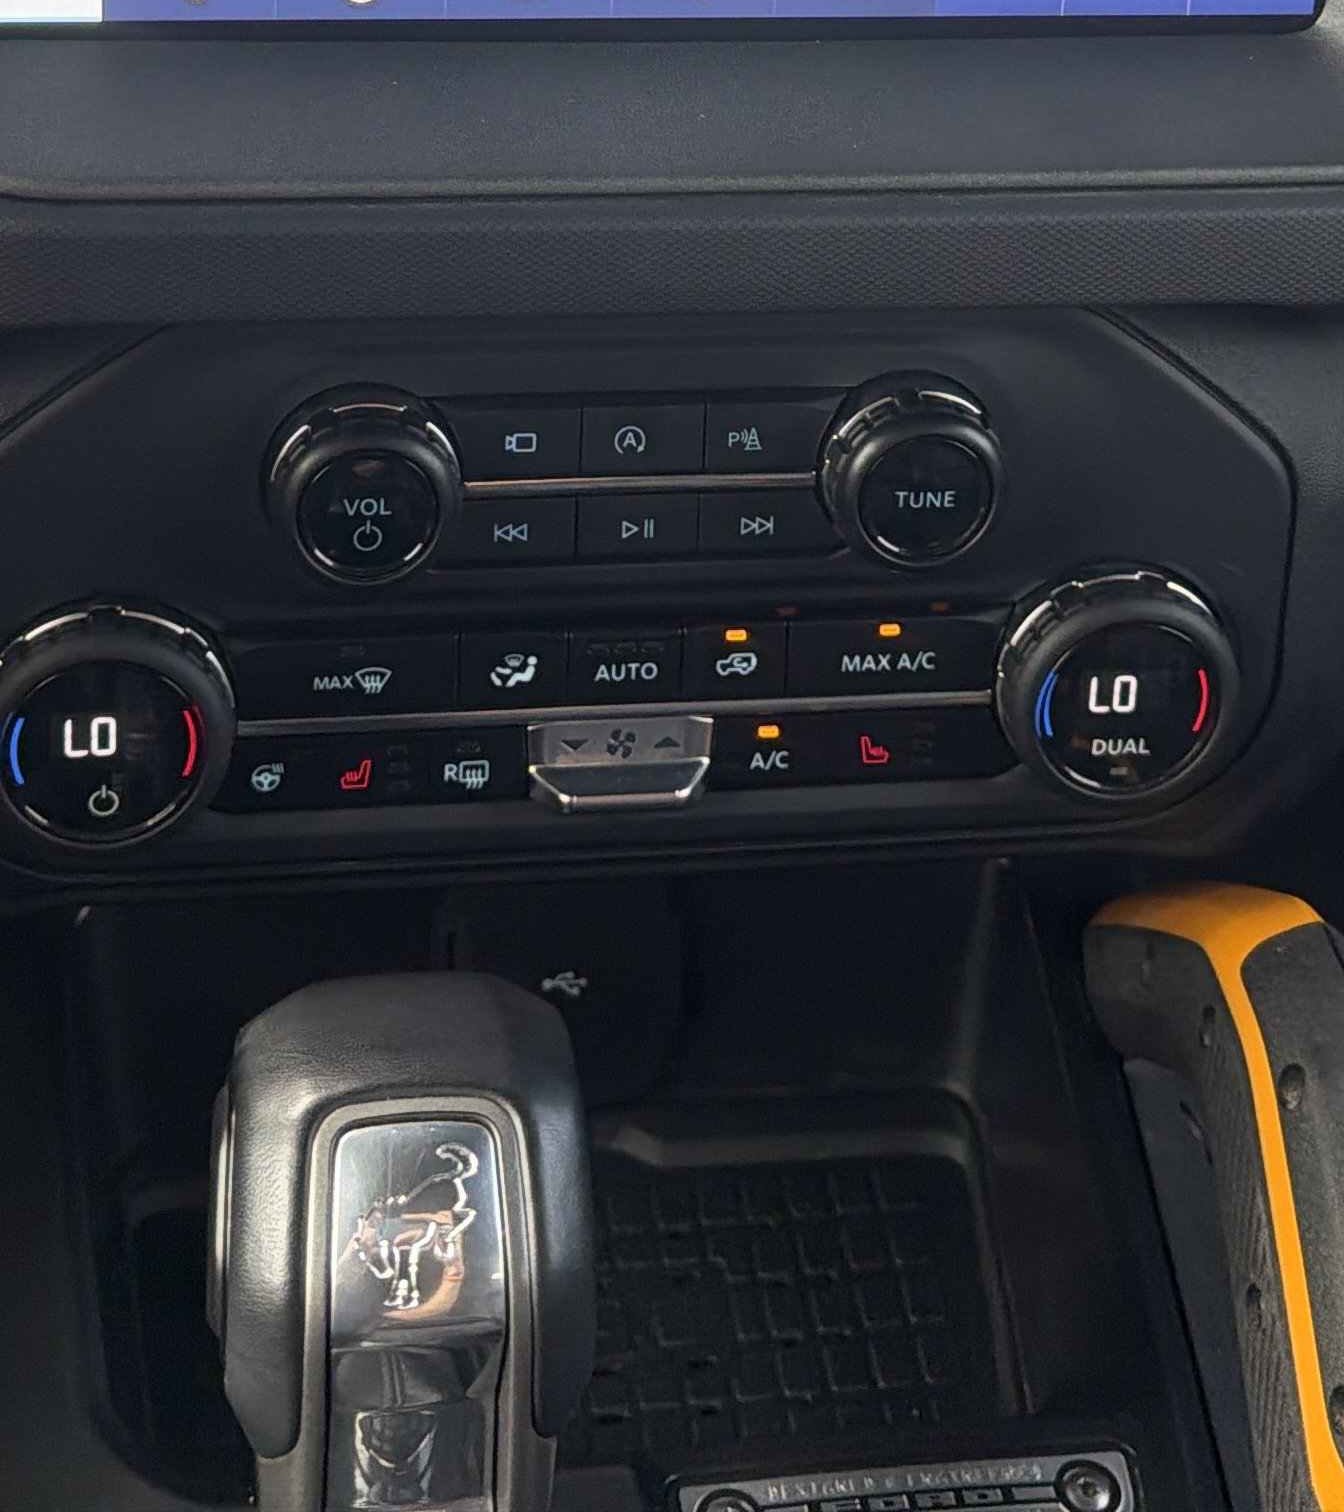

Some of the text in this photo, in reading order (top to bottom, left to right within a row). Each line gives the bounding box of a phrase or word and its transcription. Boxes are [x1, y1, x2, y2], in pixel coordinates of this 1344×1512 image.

[344, 497, 392, 517] VOL
[895, 490, 957, 509] TUNE
[595, 661, 657, 681] AUTO
[841, 651, 936, 672] MAX A/C
[313, 673, 354, 691] MAX
[1088, 675, 1138, 713] LO
[64, 716, 117, 758] LO
[1091, 738, 1149, 756] DUAL
[749, 750, 789, 771] A/C
